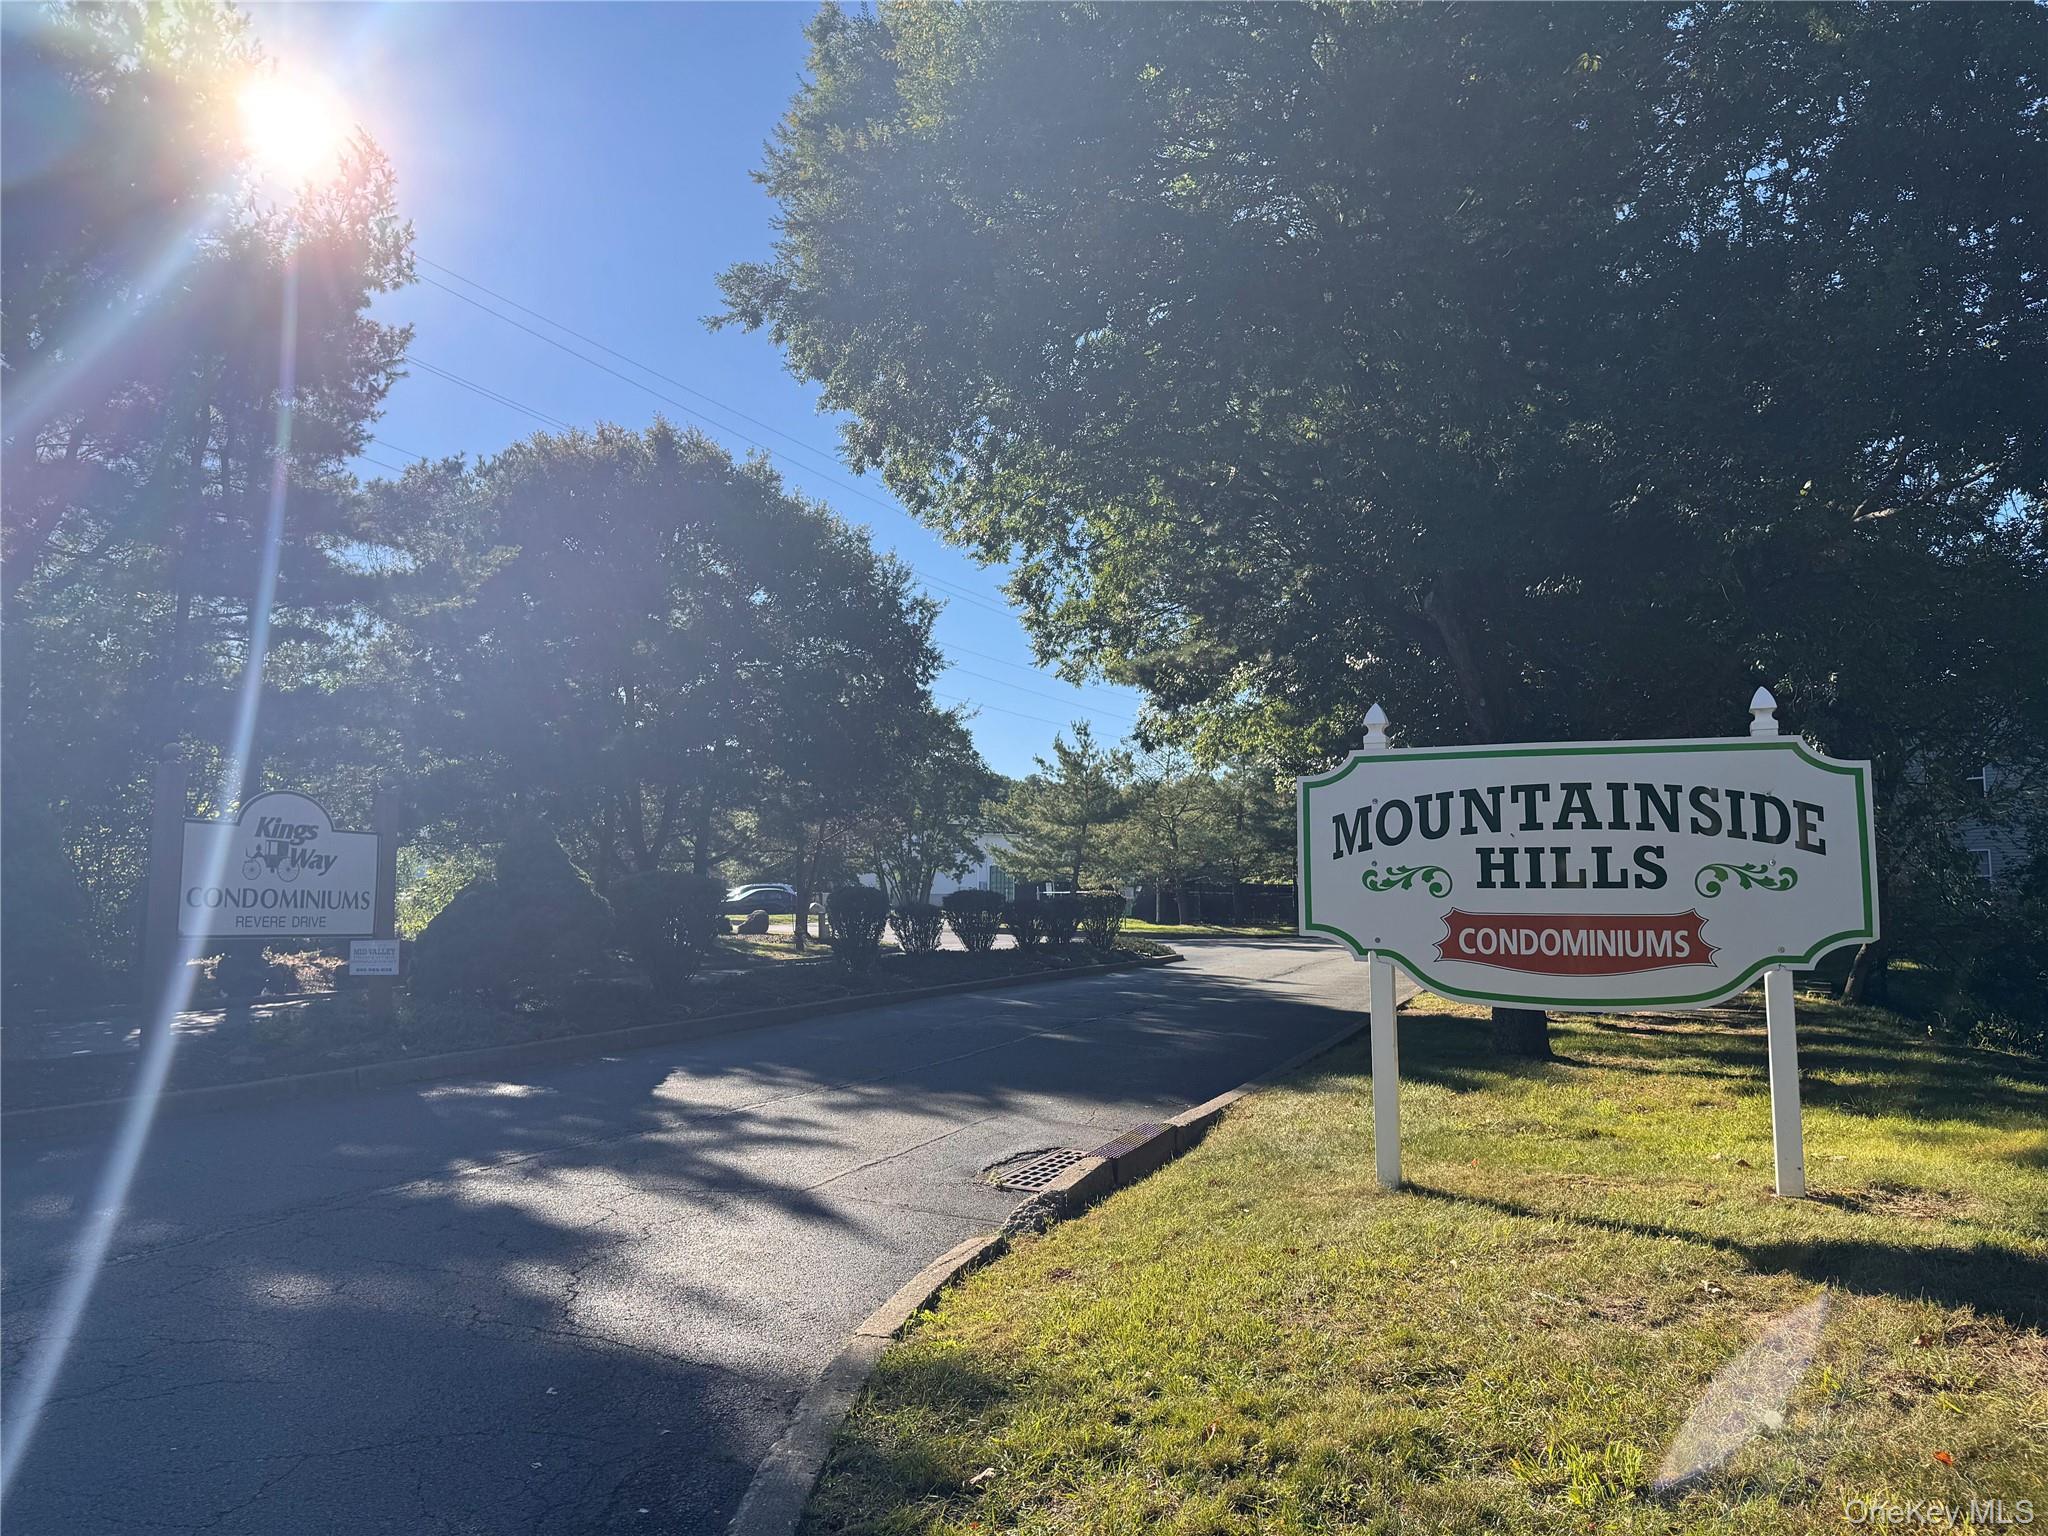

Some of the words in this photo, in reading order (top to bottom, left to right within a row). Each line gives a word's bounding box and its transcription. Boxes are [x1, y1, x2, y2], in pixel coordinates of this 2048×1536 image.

[254, 816, 319, 845] Kings
[1332, 782, 1827, 860] MOUNTAINSIDE
[290, 847, 338, 876] Way
[1476, 845, 1668, 889] HILLS
[186, 887, 370, 910] CONDOMINIUMS
[235, 915, 287, 928] REVERE
[291, 916, 327, 928] DRIVE
[1458, 927, 1690, 958] CONDOMINIUMS
